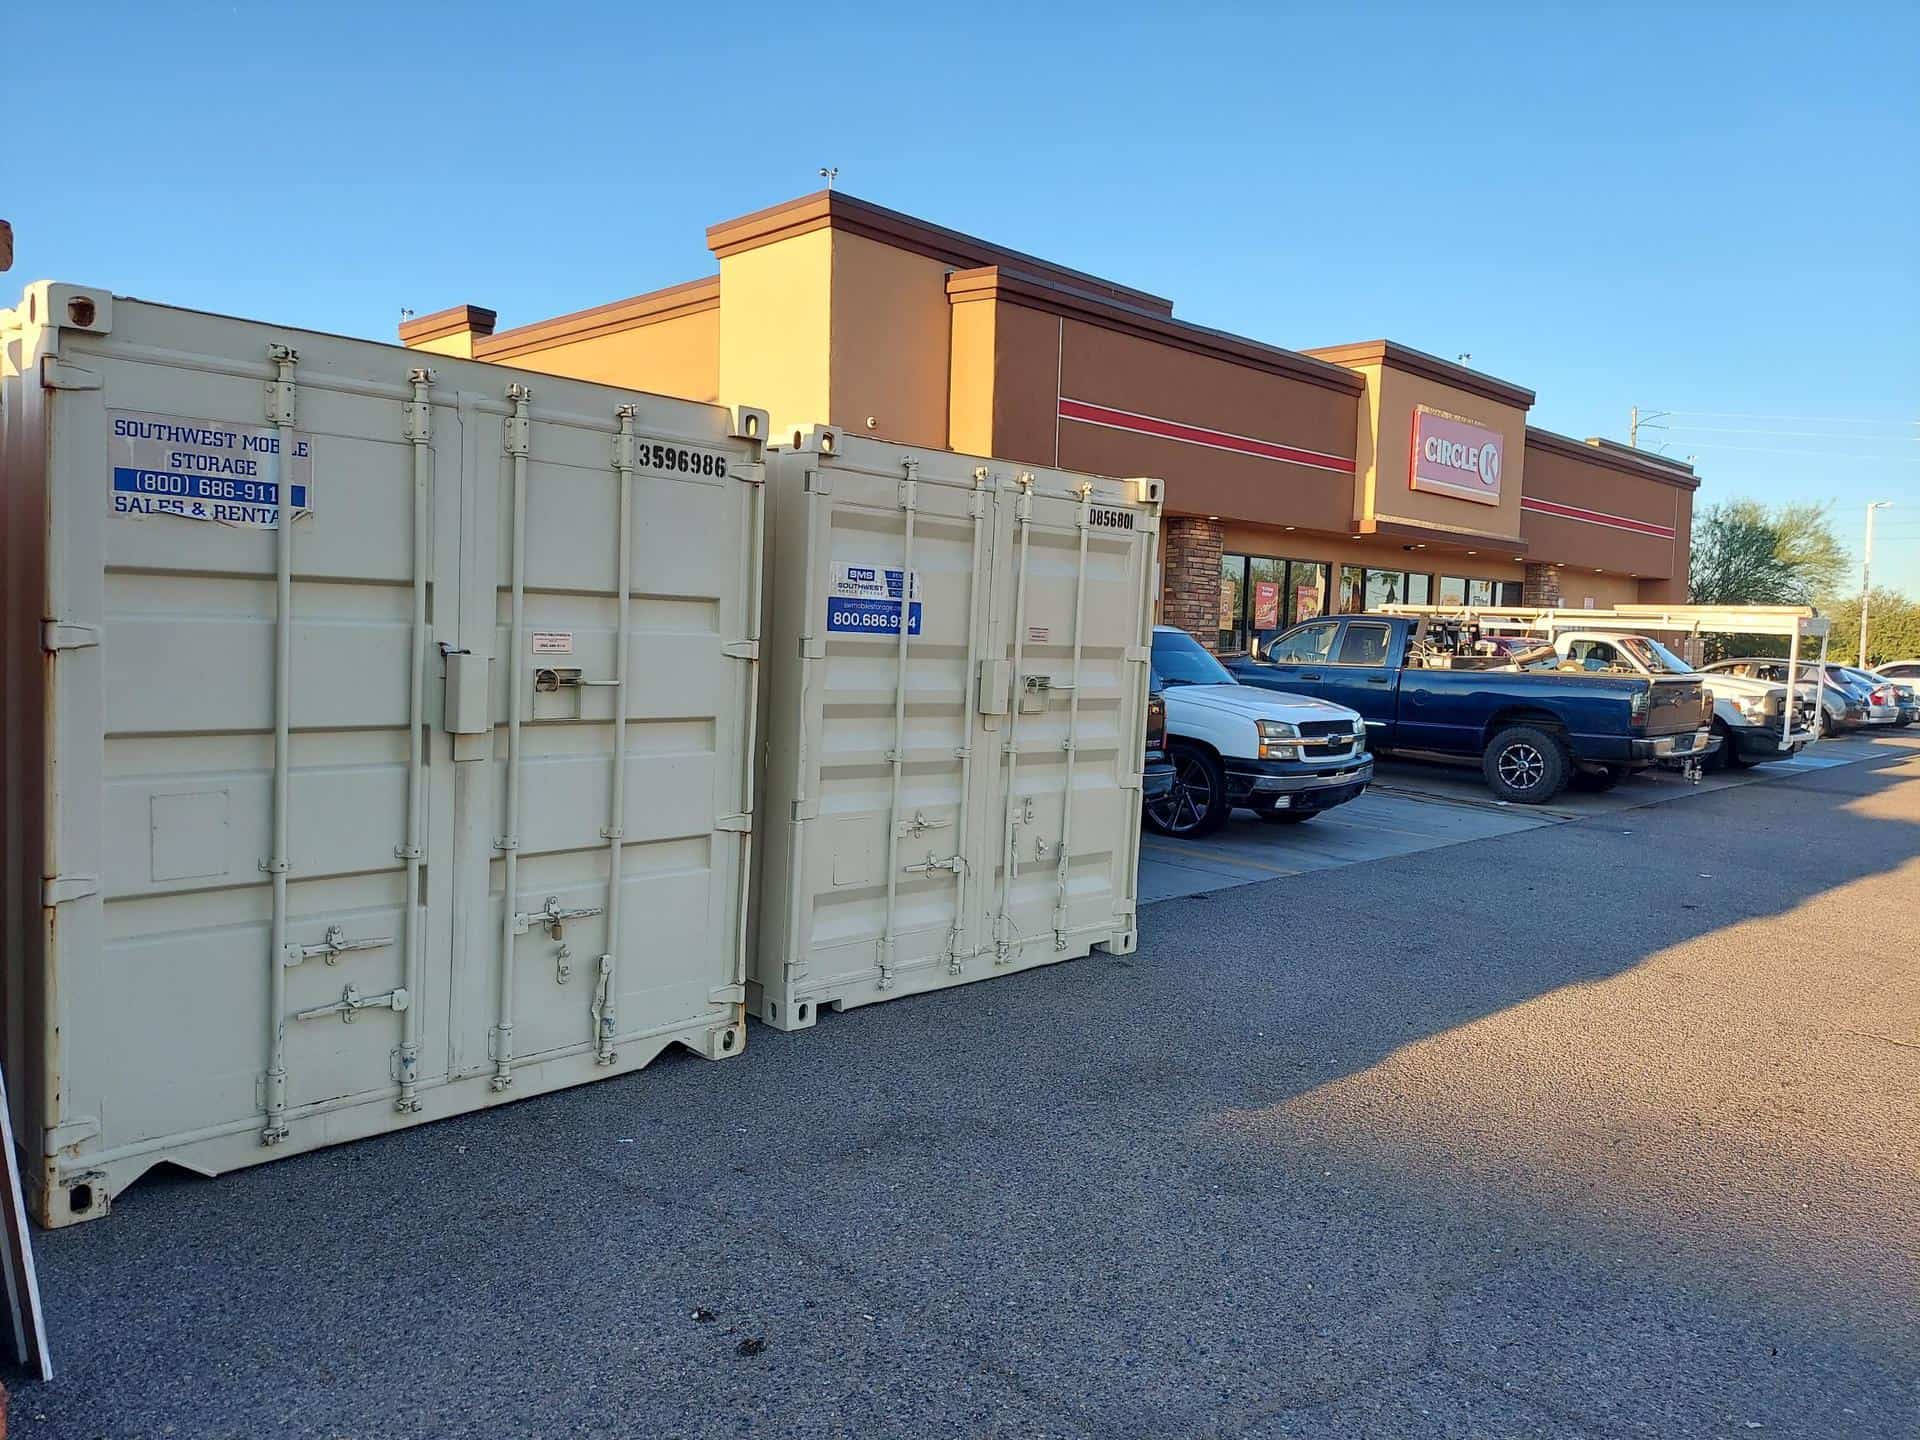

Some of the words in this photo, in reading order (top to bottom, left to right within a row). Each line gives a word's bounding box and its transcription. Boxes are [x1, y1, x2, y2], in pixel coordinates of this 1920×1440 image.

[114, 418, 237, 449] SOUTHWEST
[242, 434, 309, 458] MOBE
[171, 452, 257, 476] STORAGE
[639, 443, 727, 478] 3596986
[1424, 436, 1479, 472] CIRCLE
[1483, 447, 1498, 483] K
[136, 471, 190, 495] (800)
[199, 479, 279, 502] 686-911
[191, 501, 207, 517] &
[213, 503, 301, 524] RENTA
[849, 569, 873, 580] SMS
[837, 582, 883, 592] SOUTHWEST
[833, 612, 916, 628] 800.686.94
